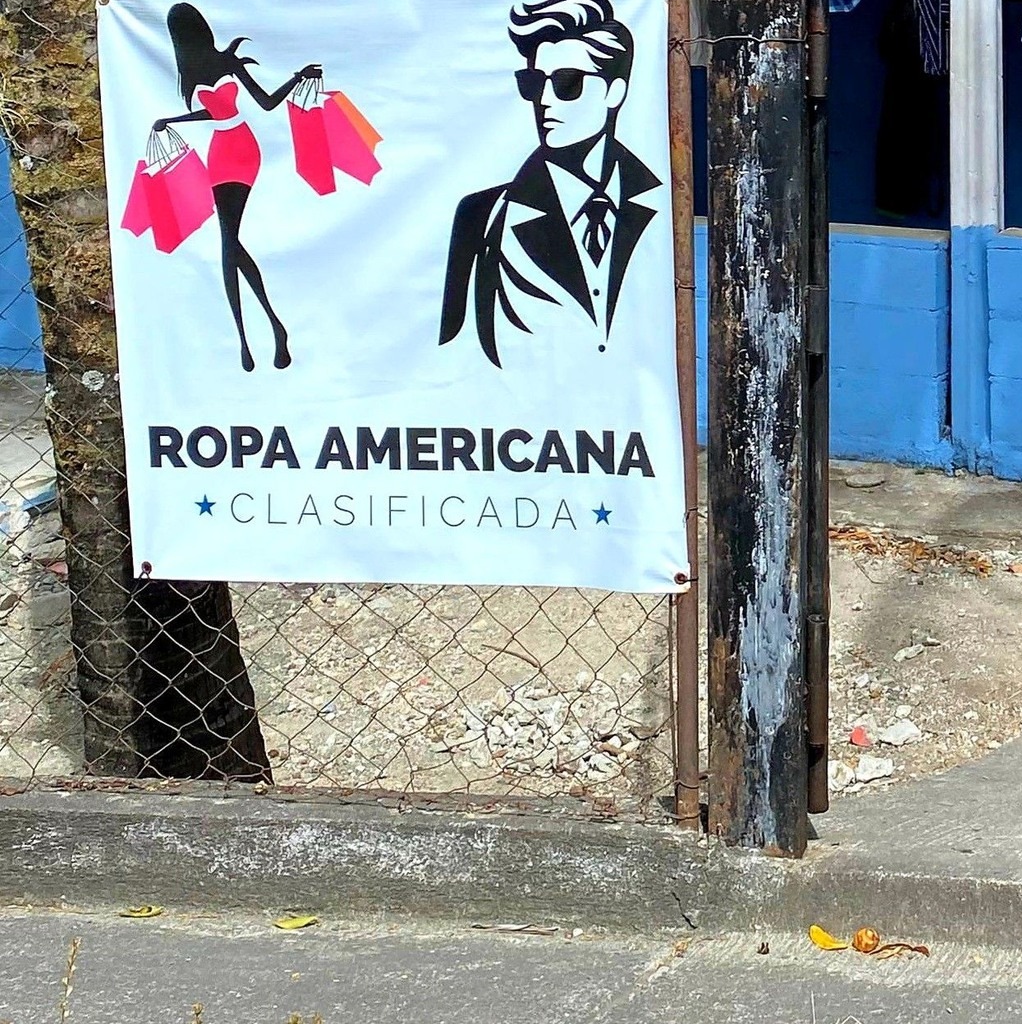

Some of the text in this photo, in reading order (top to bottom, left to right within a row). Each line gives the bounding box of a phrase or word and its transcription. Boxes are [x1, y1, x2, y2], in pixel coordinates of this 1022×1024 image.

[148, 425, 655, 478] ROPA AMERICANA
[230, 492, 577, 530] CLASIFICADA
